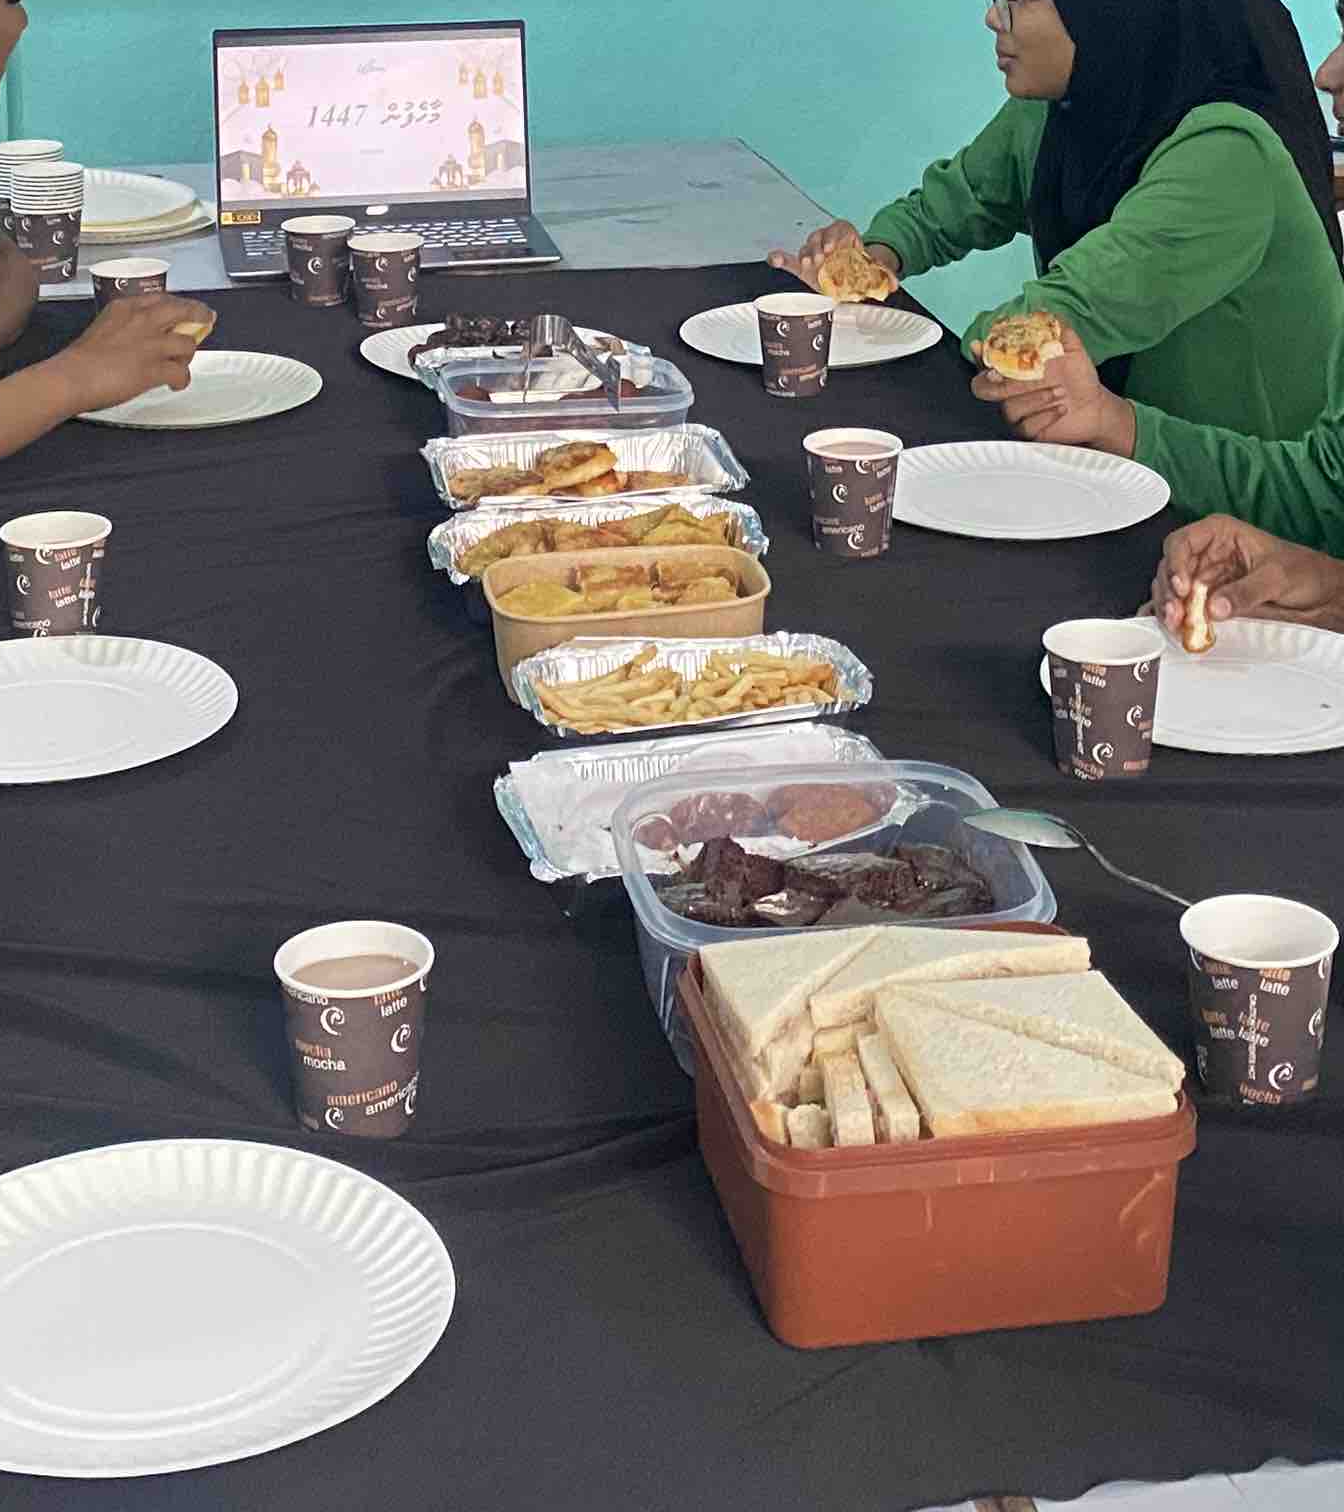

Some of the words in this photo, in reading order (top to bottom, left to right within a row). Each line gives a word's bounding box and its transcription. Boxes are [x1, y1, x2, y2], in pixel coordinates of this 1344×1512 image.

[307, 104, 369, 129] 1447
[380, 996, 408, 1017] latte
[303, 1055, 347, 1072] mocha
